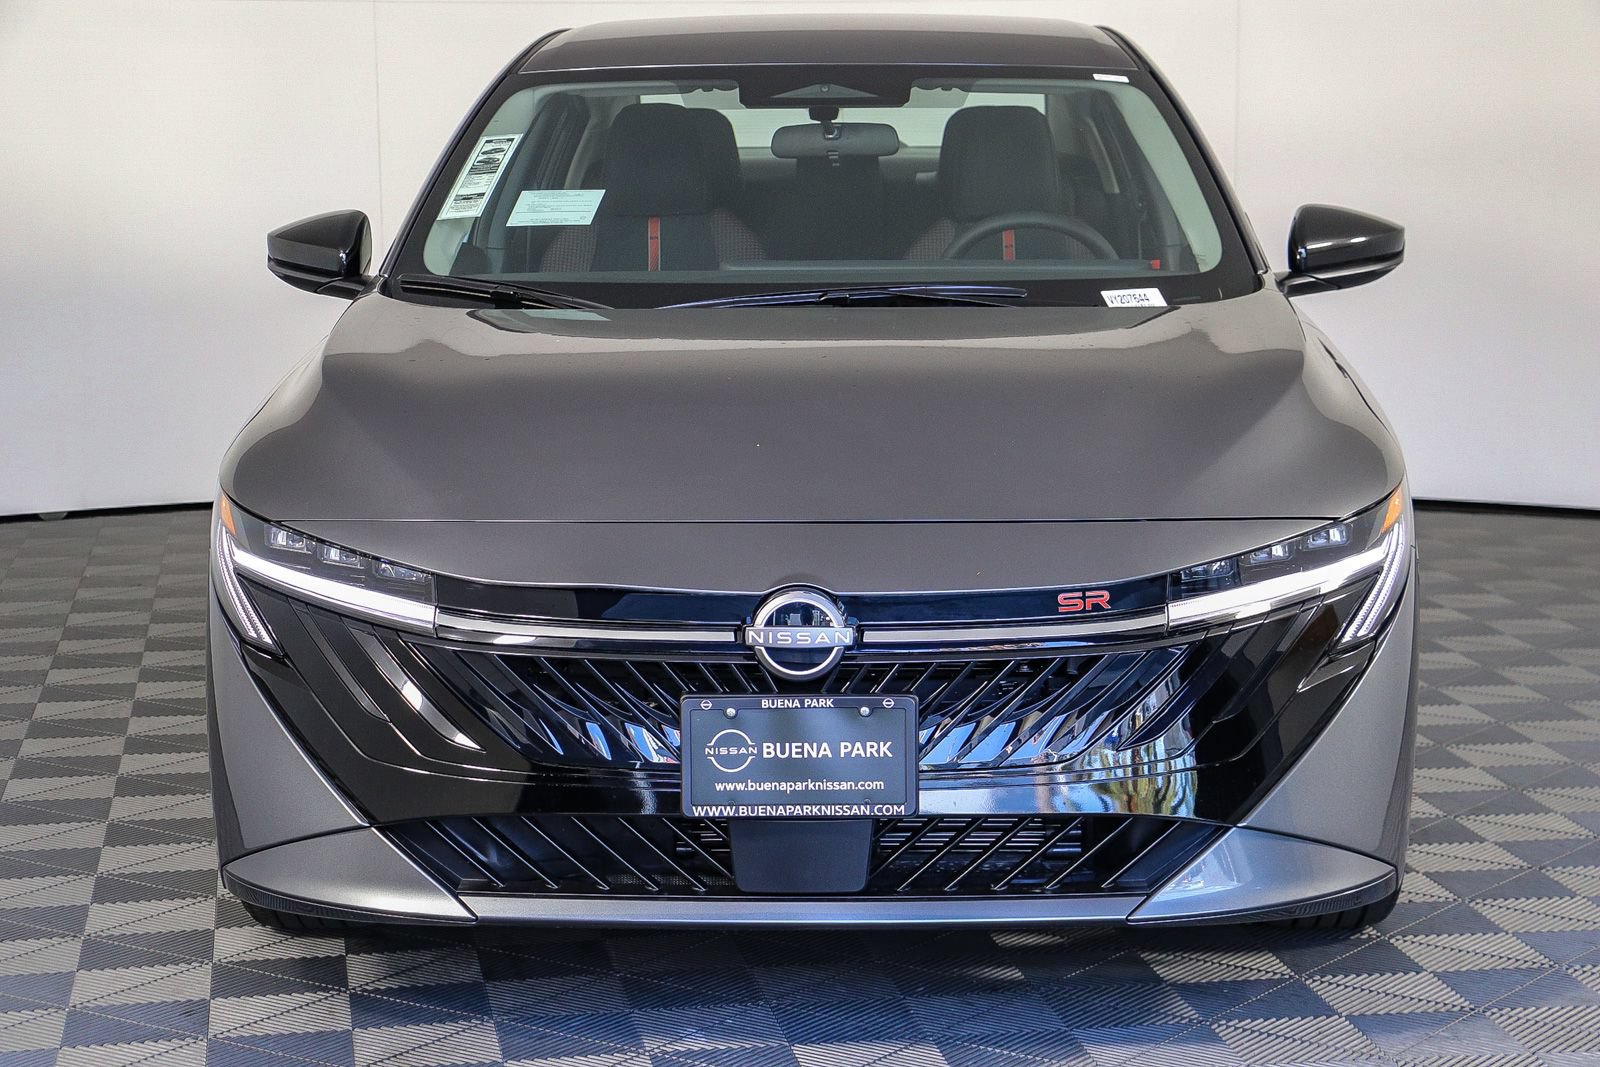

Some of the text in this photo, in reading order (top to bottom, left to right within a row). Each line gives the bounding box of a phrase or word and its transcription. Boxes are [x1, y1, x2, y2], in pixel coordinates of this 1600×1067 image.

[1057, 590, 1111, 612] SR
[748, 631, 850, 644] NISSAN
[761, 698, 834, 708] BUENA PARK
[705, 746, 757, 755] NISSAN
[762, 741, 893, 759] BUENA PARK
[715, 779, 884, 794] www.buenaparknissan.com
[692, 804, 905, 816] WWW.BUENAPARKNISSAN.COM
